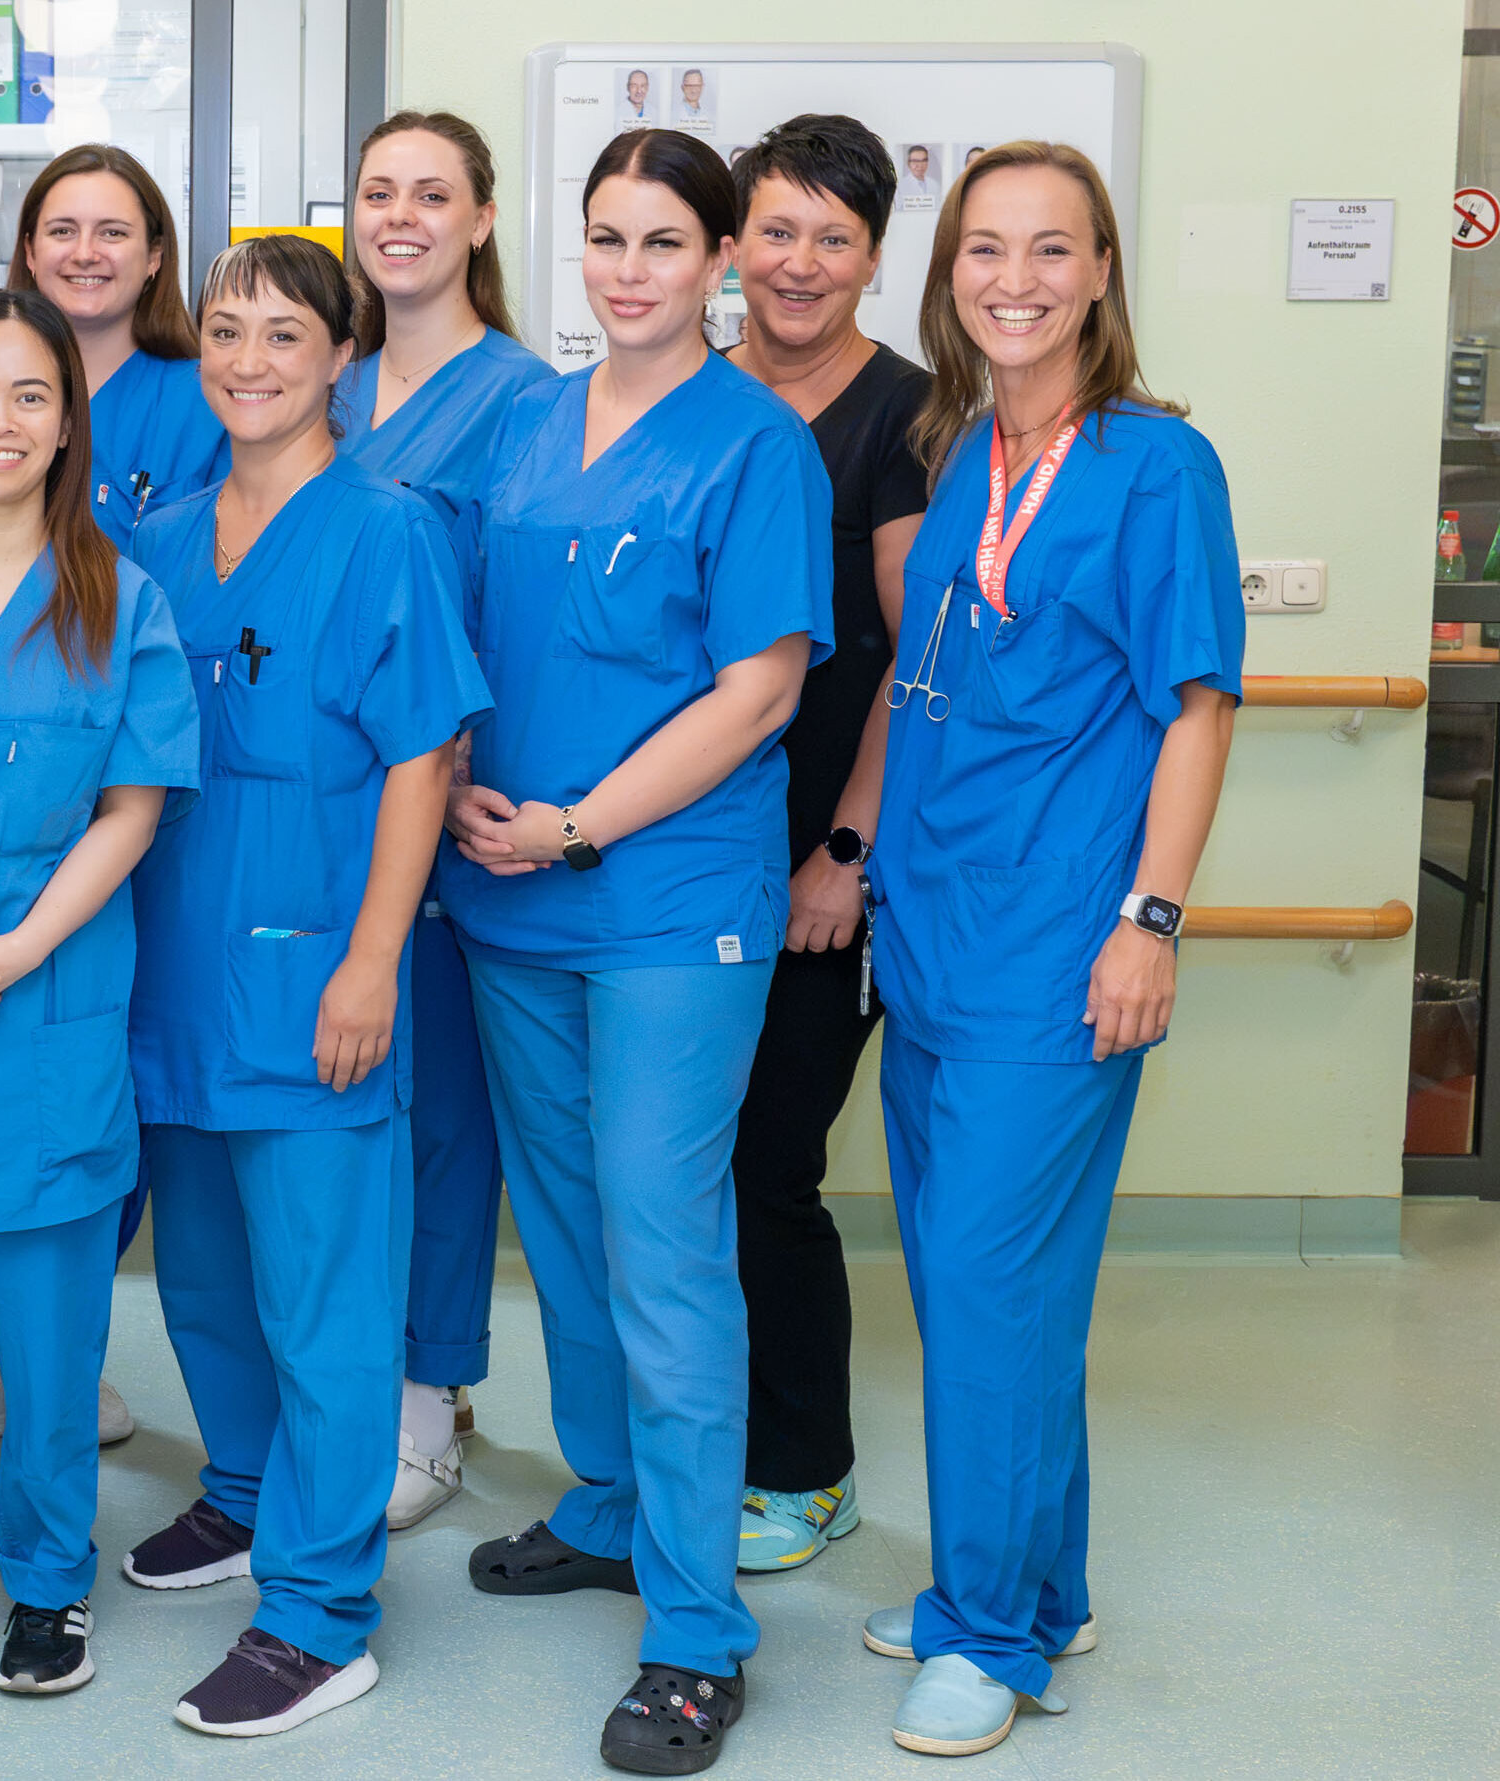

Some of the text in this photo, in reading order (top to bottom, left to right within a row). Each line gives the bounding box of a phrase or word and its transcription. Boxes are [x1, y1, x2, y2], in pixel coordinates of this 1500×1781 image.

[1338, 205, 1368, 214] 0.2155
[1307, 241, 1371, 249] Aufenthaltsraum
[1323, 251, 1357, 259] Personal
[1021, 425, 1076, 515] HAND ANS
[989, 466, 1003, 514] HAND
[982, 516, 999, 546] ANS
